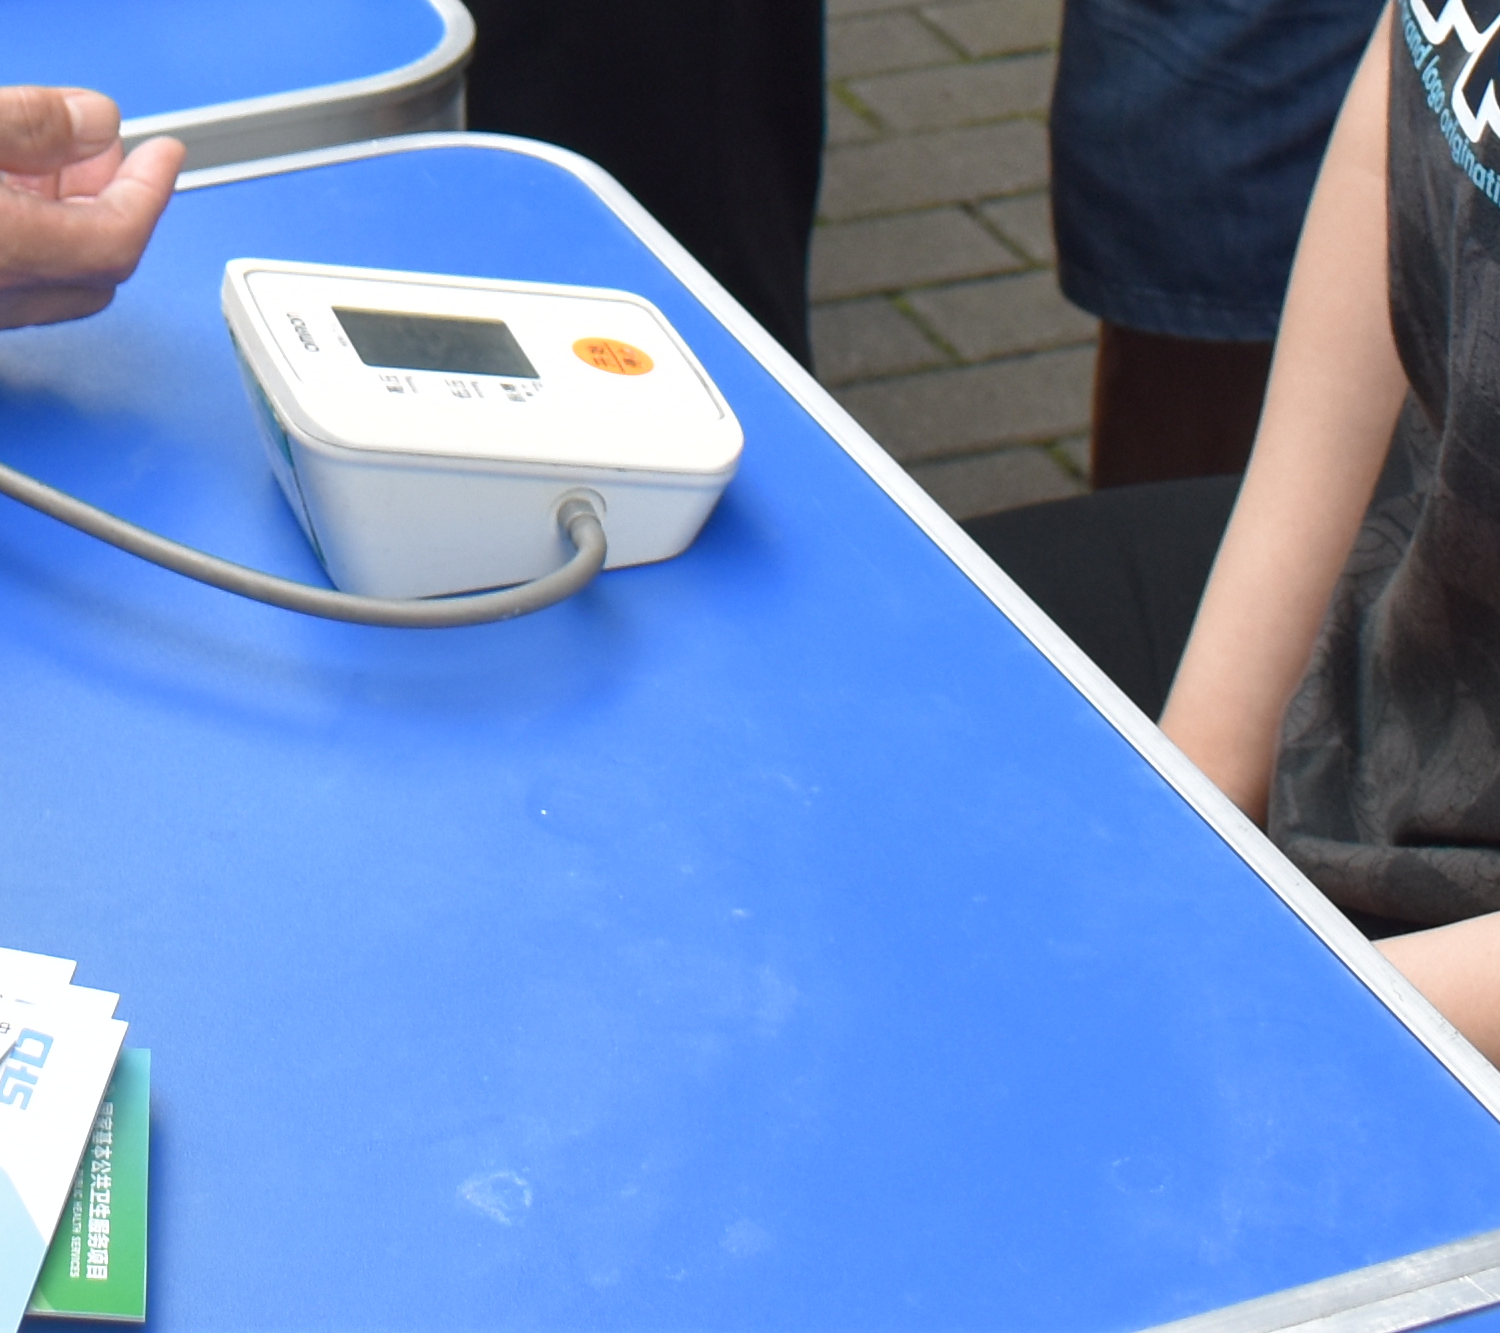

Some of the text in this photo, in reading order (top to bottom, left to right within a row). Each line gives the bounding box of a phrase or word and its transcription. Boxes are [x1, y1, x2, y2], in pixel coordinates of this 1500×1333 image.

[1420, 55, 1445, 114] logo
[85, 1101, 114, 1280] 国家基本公共卫生服务项目
[71, 1201, 83, 1234] HEALTH
[69, 1235, 82, 1278] SERVICES
